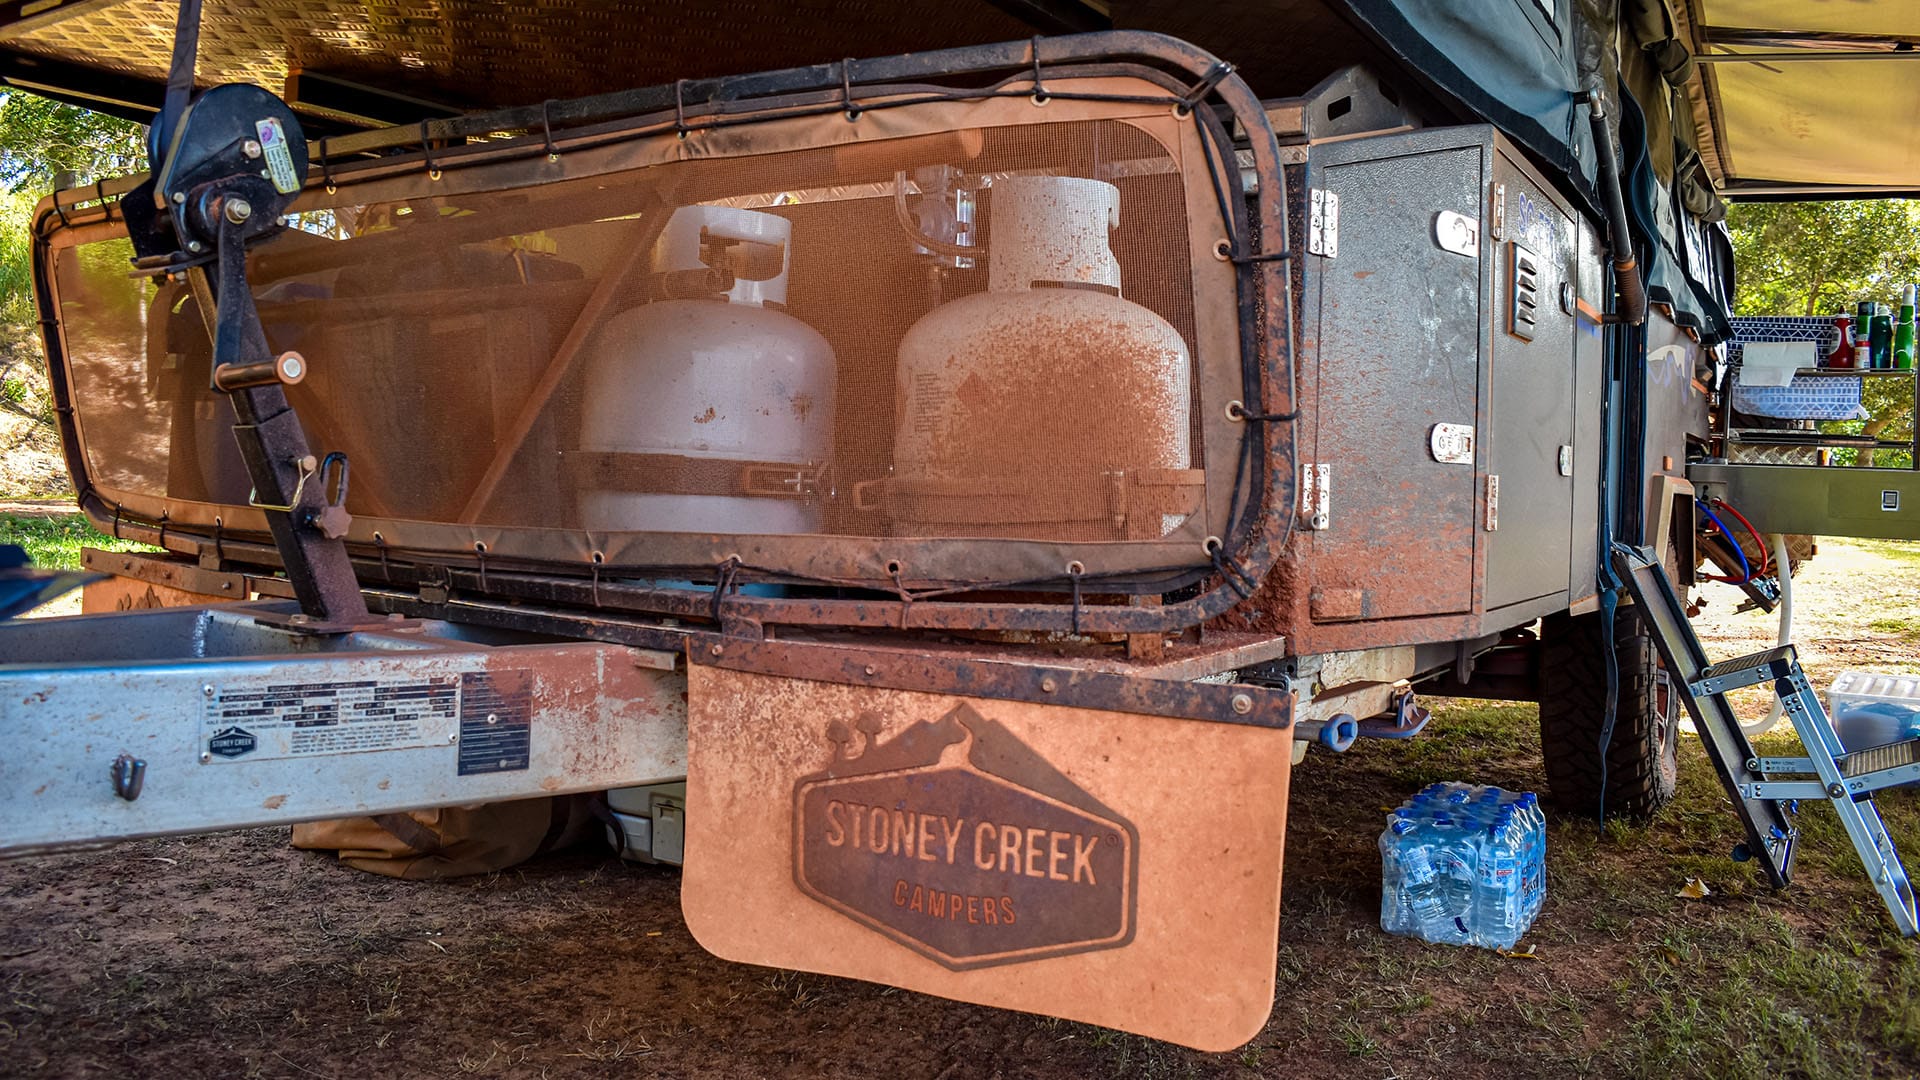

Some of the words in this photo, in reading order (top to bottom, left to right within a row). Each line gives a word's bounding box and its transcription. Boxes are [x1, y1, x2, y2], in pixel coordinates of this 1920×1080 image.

[826, 799, 964, 865] STONEY
[974, 821, 1099, 886] CREEK
[893, 879, 1017, 925] CAMPERS
